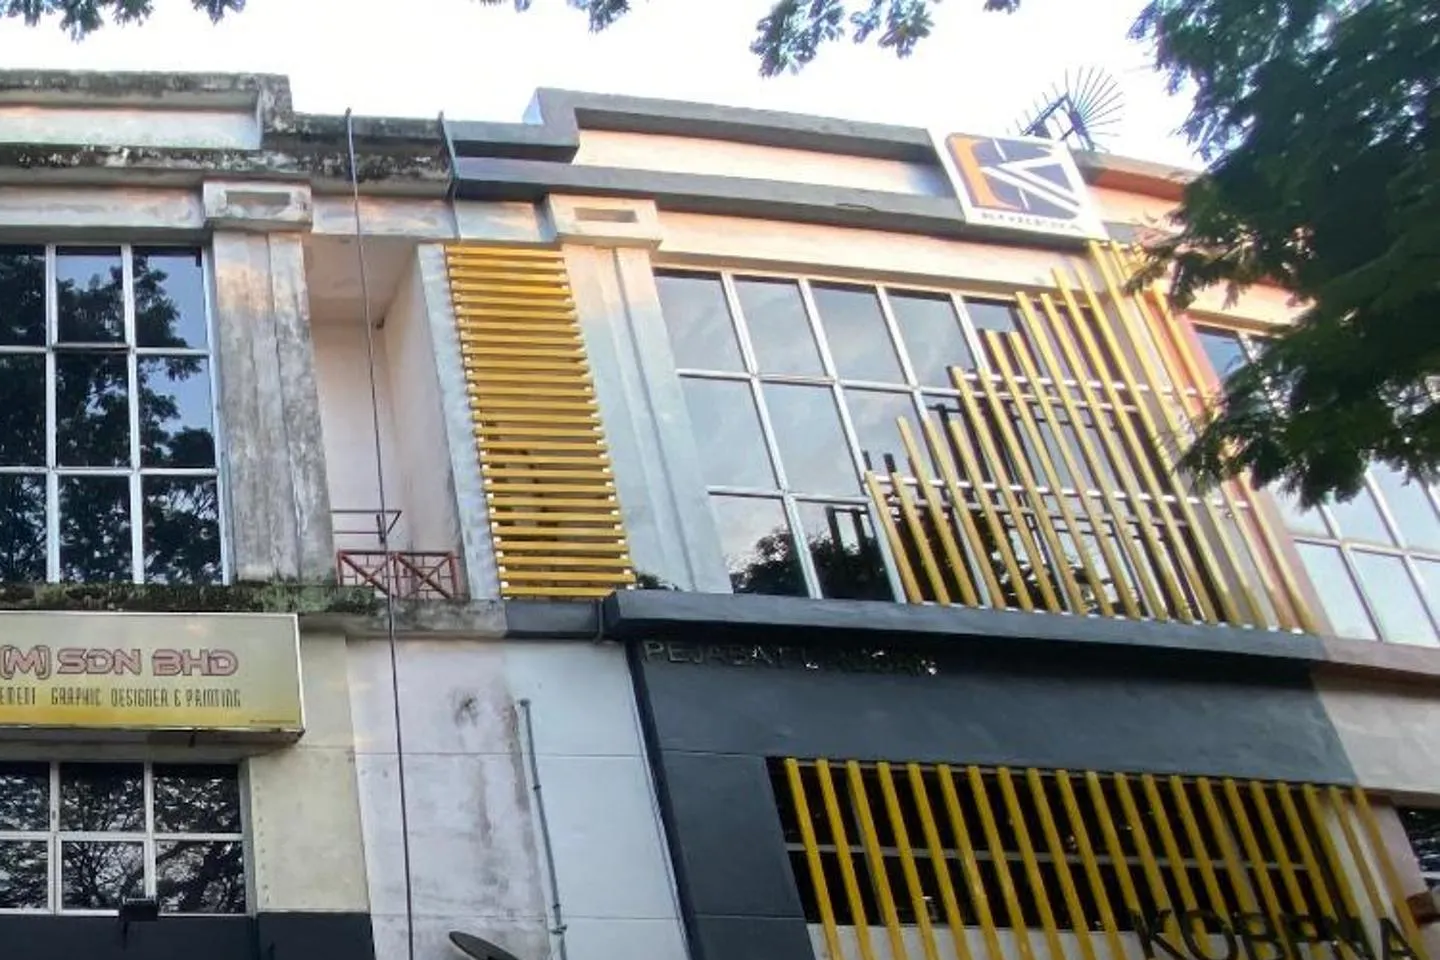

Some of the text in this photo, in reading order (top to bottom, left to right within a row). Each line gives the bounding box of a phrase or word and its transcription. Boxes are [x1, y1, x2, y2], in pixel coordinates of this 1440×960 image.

[56, 648, 142, 675] SDN
[152, 648, 239, 677] BHD
[50, 687, 103, 706] GRAPHIC
[110, 687, 170, 707] DESIGNER
[185, 688, 242, 708] PRINTING
